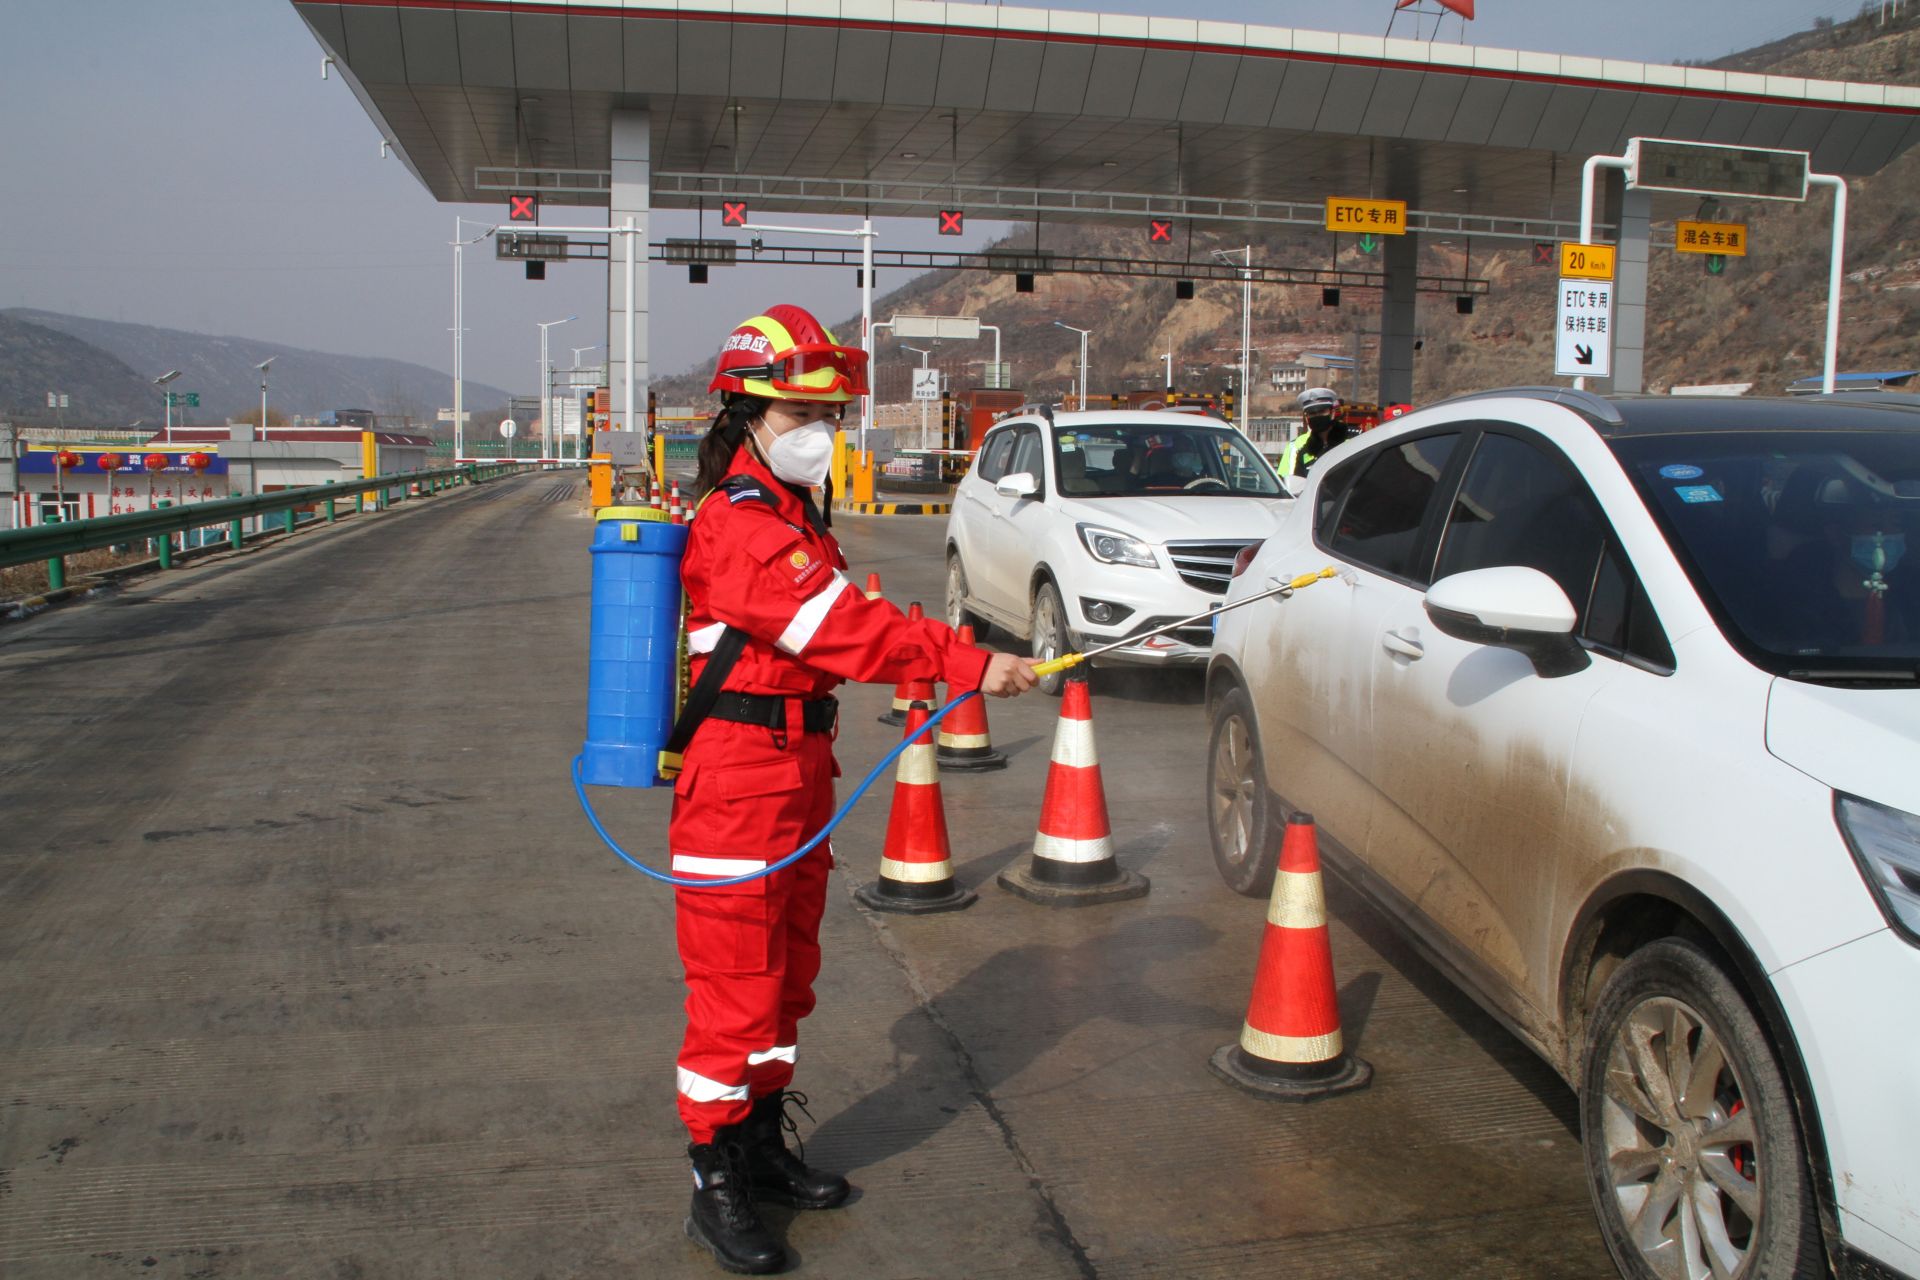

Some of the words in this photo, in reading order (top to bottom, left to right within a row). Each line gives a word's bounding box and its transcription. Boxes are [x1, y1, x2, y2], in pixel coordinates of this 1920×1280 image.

[1336, 207, 1363, 222] ETC
[1368, 209, 1396, 223] 专用
[1684, 230, 1738, 246] 混合车道
[1570, 252, 1585, 269] 20
[1566, 291, 1585, 307] ETC
[1588, 292, 1607, 308] 专用
[1566, 316, 1606, 332] 保持车距
